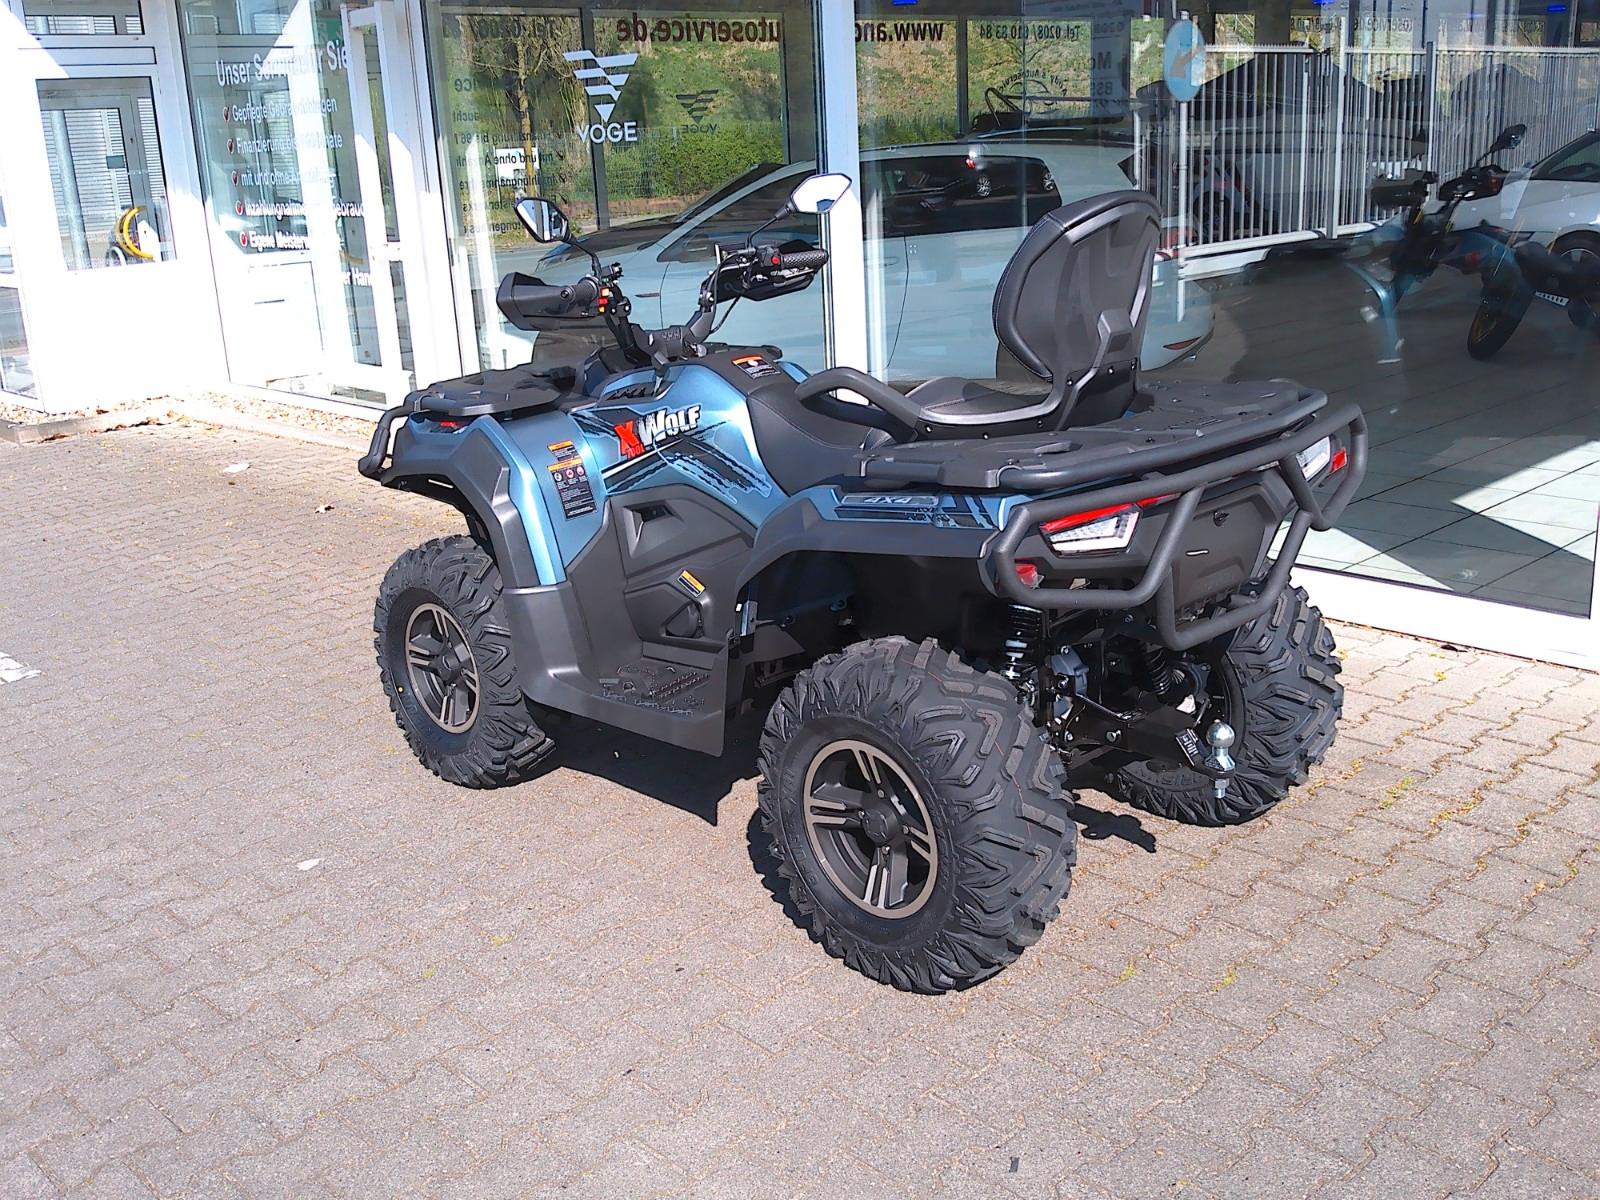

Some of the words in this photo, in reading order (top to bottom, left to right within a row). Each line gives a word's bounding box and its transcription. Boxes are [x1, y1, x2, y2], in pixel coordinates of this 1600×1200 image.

[215, 59, 251, 87] Unser
[326, 39, 350, 71] Sie
[576, 121, 638, 144] VOGE
